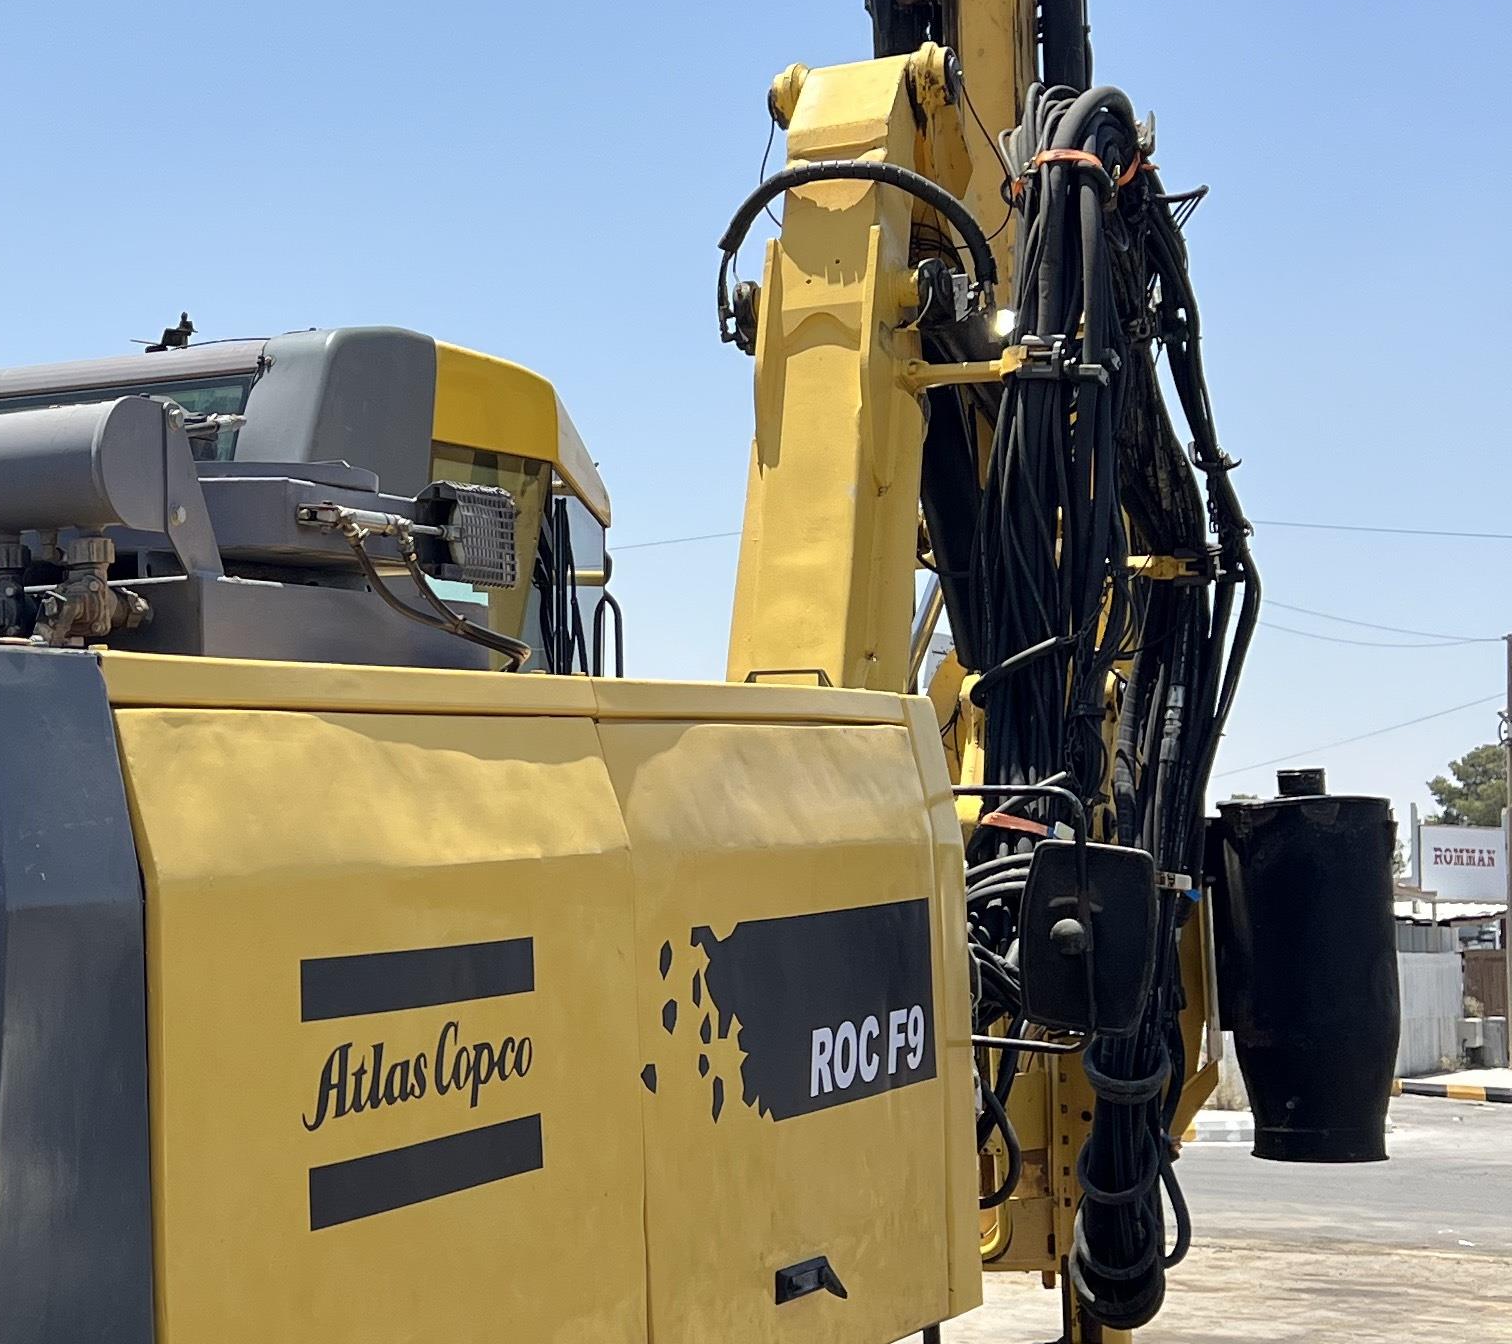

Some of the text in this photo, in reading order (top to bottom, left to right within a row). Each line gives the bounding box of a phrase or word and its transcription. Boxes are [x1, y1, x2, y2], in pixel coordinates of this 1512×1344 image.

[1433, 847, 1495, 867] ROMMAN
[302, 1020, 532, 1131] Atlas Copco
[810, 1005, 925, 1097] ROC F9
